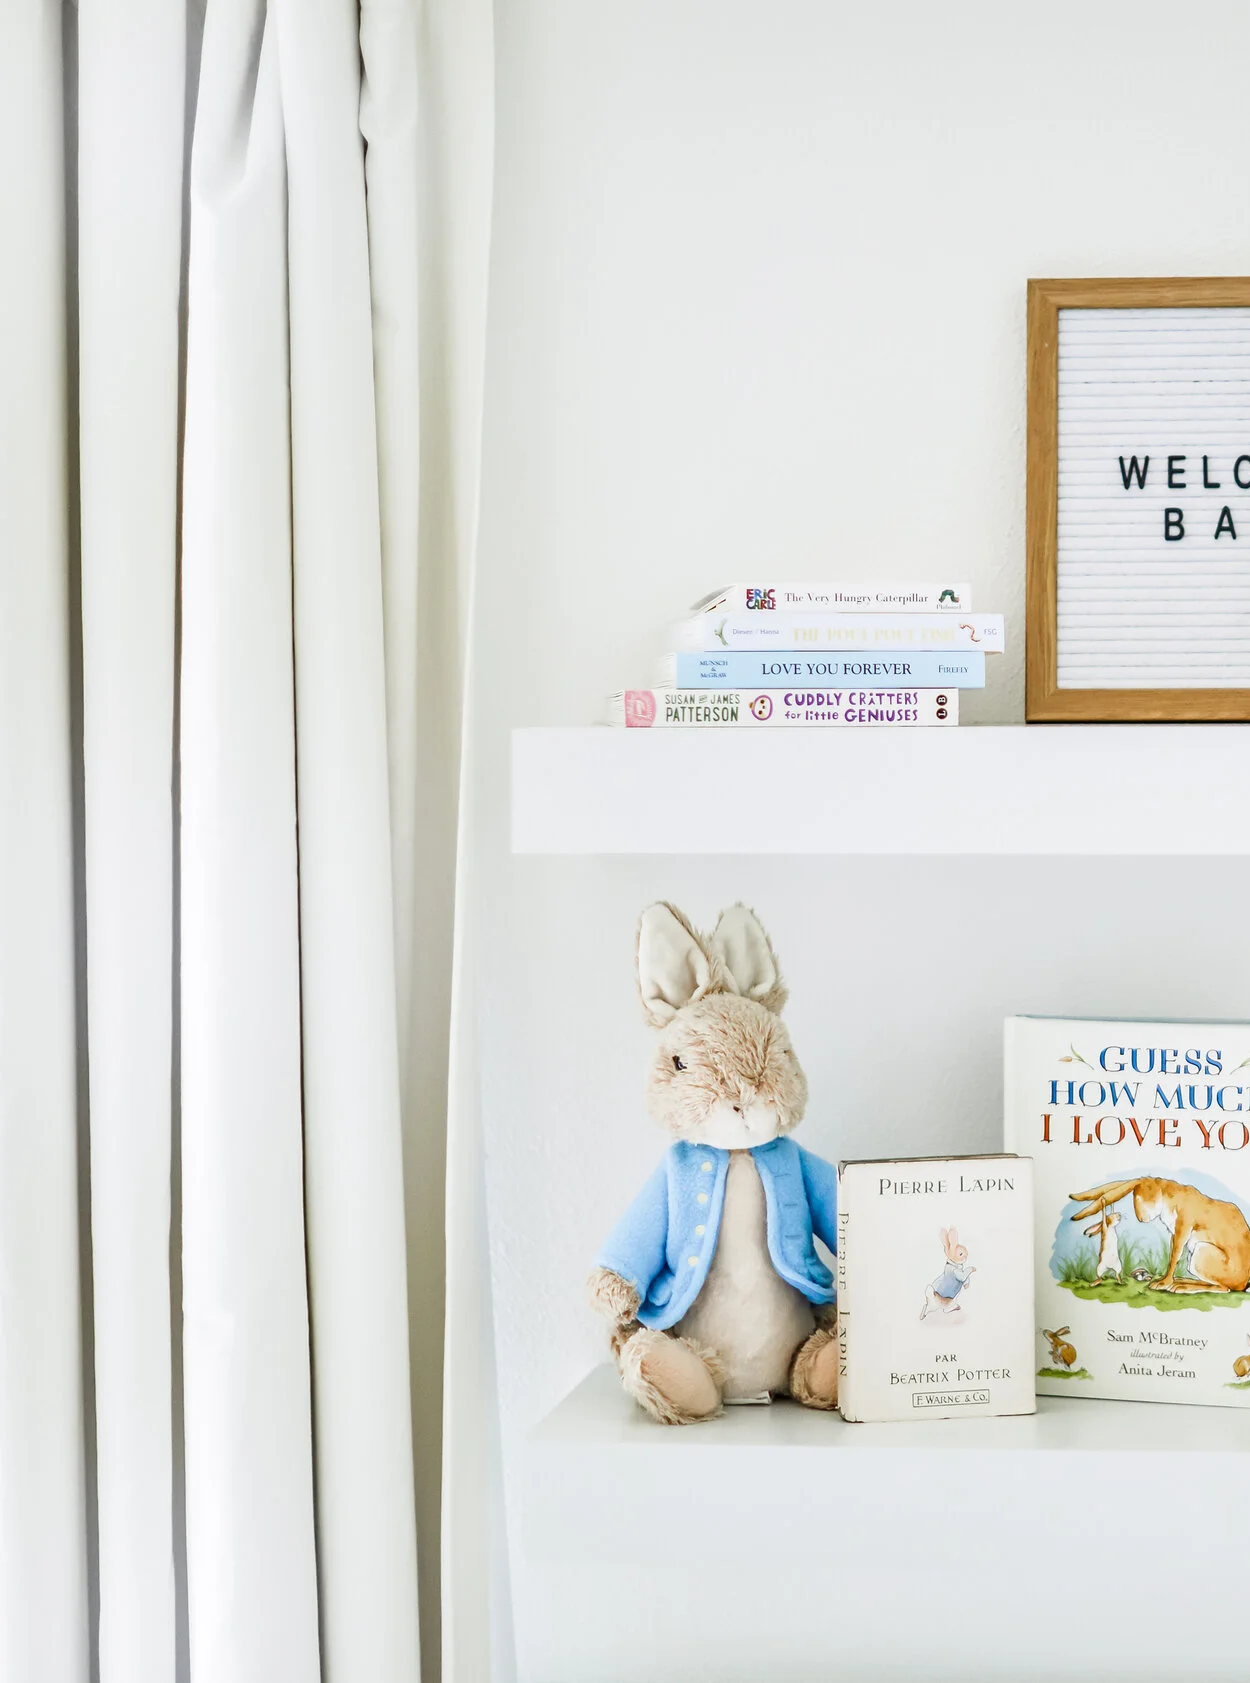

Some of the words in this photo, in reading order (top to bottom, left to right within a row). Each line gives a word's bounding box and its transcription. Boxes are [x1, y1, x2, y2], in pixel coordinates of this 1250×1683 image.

[746, 599, 777, 610] CARLE
[784, 592, 804, 602] The
[807, 592, 829, 605] Very
[835, 592, 871, 605] Hungry
[876, 592, 929, 605] Caterpillar
[983, 628, 998, 636] FSG
[762, 663, 802, 675] LOVE
[806, 663, 838, 675] YOU
[843, 663, 912, 675] FOREVER
[665, 694, 696, 705] SUSAN
[710, 693, 741, 705] JAMES
[783, 692, 843, 706] CUDDLY
[666, 706, 739, 722] PATTERSON
[785, 711, 801, 720] for
[805, 710, 839, 721] little
[844, 708, 918, 722] GENIUSES
[1099, 1045, 1223, 1075] GUESS
[1047, 1079, 1143, 1107] HOW
[1040, 1113, 1054, 1144] I
[1069, 1114, 1182, 1149] LOVE
[879, 1177, 947, 1196] PIERRE
[959, 1175, 1016, 1193] LAPIN
[1106, 1329, 1134, 1343] Sam
[1138, 1331, 1208, 1350] McBratney
[935, 1353, 958, 1363] PAR
[1129, 1349, 1172, 1360] illustrated
[1173, 1350, 1185, 1362] by
[890, 1371, 950, 1385] BEATRIX
[957, 1367, 1012, 1382] POTTER
[1118, 1363, 1153, 1377] Anita
[1156, 1364, 1197, 1379] Jeram
[925, 1393, 961, 1405] WARNE
[964, 1393, 971, 1403] &
